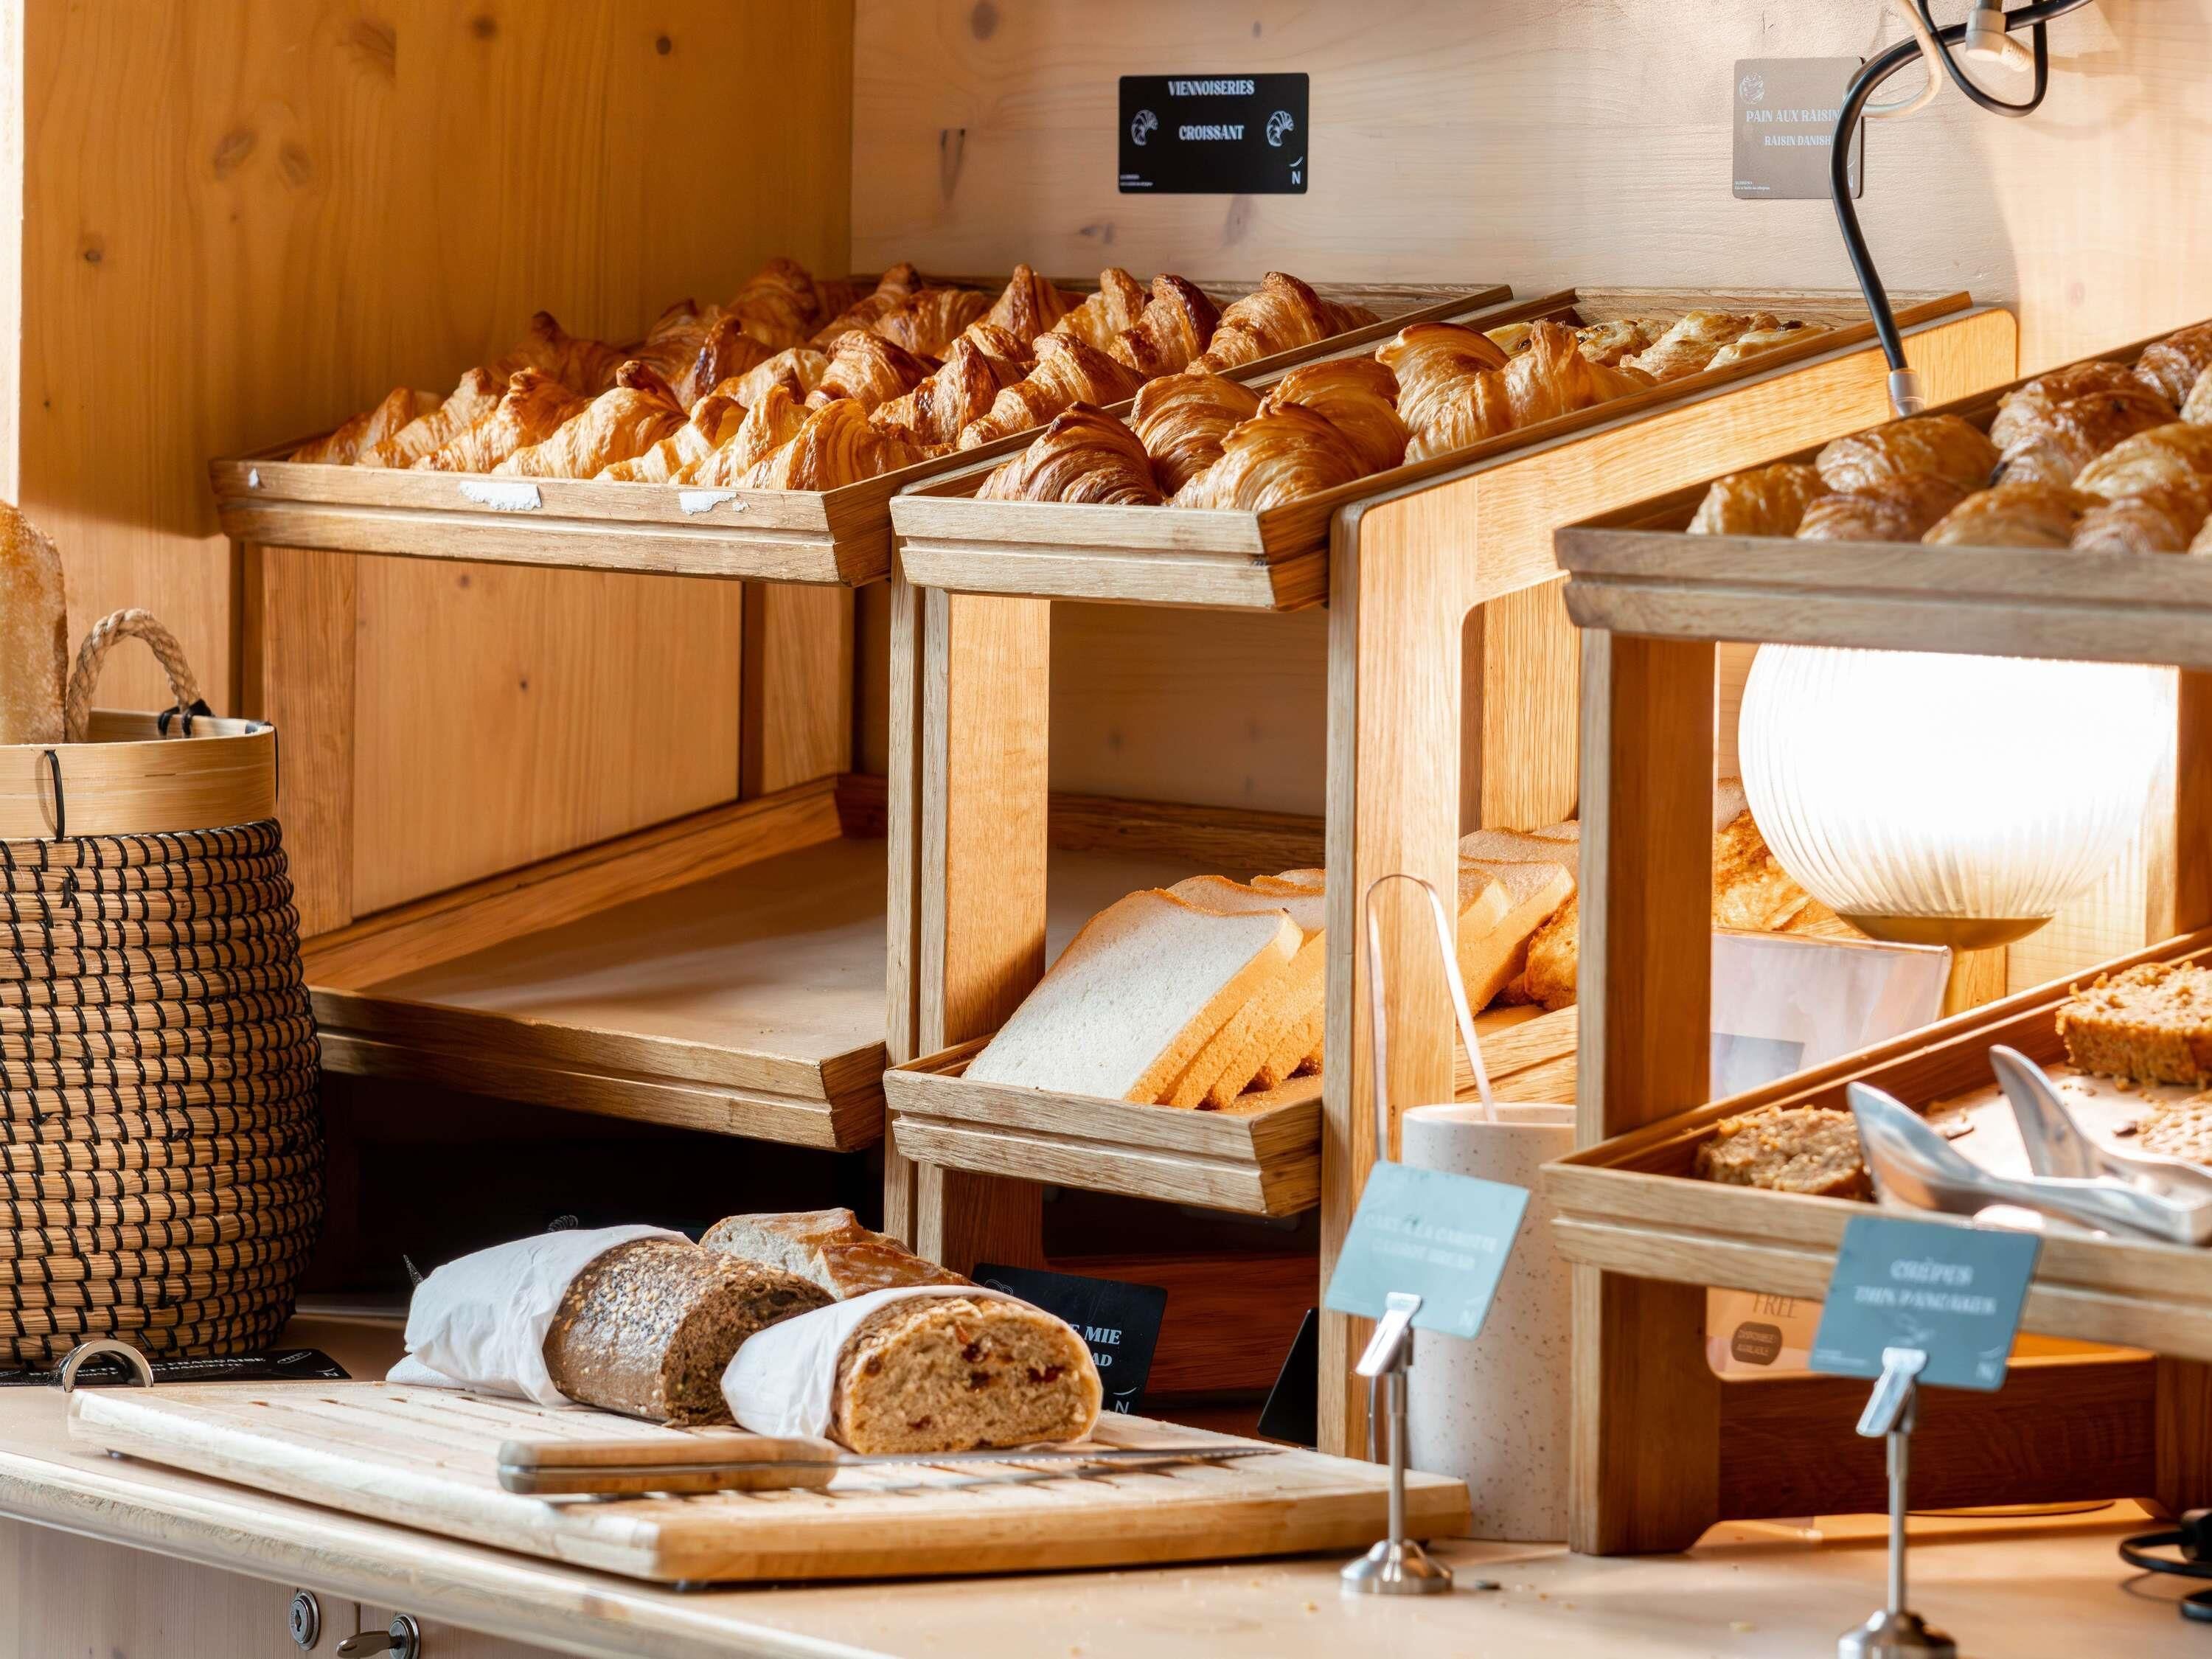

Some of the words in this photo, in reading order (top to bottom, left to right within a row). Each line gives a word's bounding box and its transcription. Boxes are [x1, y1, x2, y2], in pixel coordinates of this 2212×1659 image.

[1168, 80, 1255, 96] VIENNOISERIES
[1746, 110, 1773, 122] PAIN
[1776, 110, 1799, 122] AUX
[1802, 109, 1840, 122] RAISIN
[1179, 124, 1245, 141] CROISSANT
[1764, 135, 1796, 146] RAISIN
[1798, 135, 1832, 146] DANISH
[1291, 171, 1301, 184] N
[1752, 1293, 1799, 1320] FREE
[1084, 1326, 1122, 1345] MIE
[1114, 1399, 1130, 1415] N
